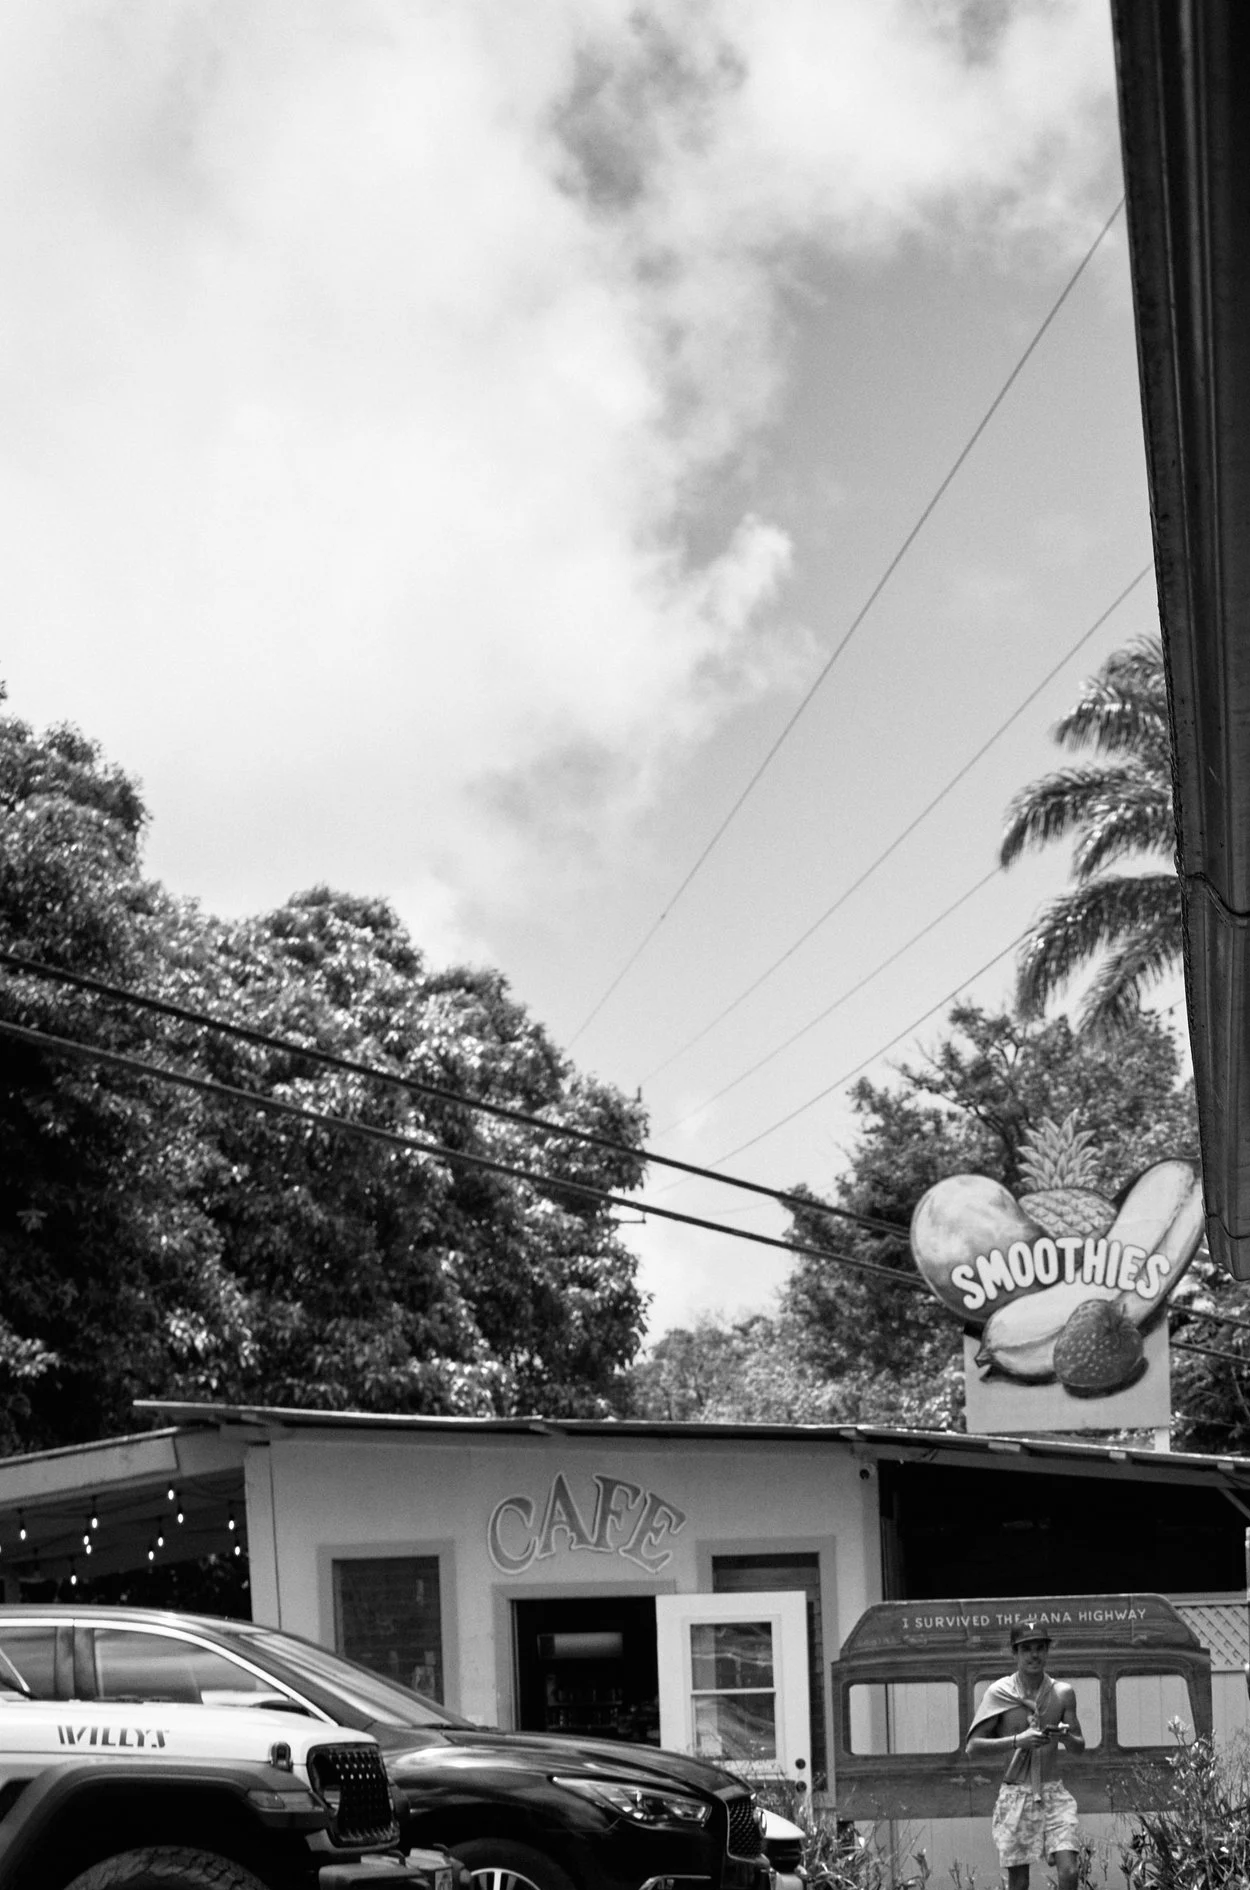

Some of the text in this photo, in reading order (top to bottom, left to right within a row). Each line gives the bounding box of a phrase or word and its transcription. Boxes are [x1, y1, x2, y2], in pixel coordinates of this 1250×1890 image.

[951, 1236, 1171, 1310] SMOOTHIES
[487, 1472, 687, 1575] CAFE
[902, 1618, 908, 1628] I
[915, 1616, 990, 1628] SURVIVED
[996, 1613, 1020, 1625] THE
[1078, 1608, 1148, 1621] HIGHWAY
